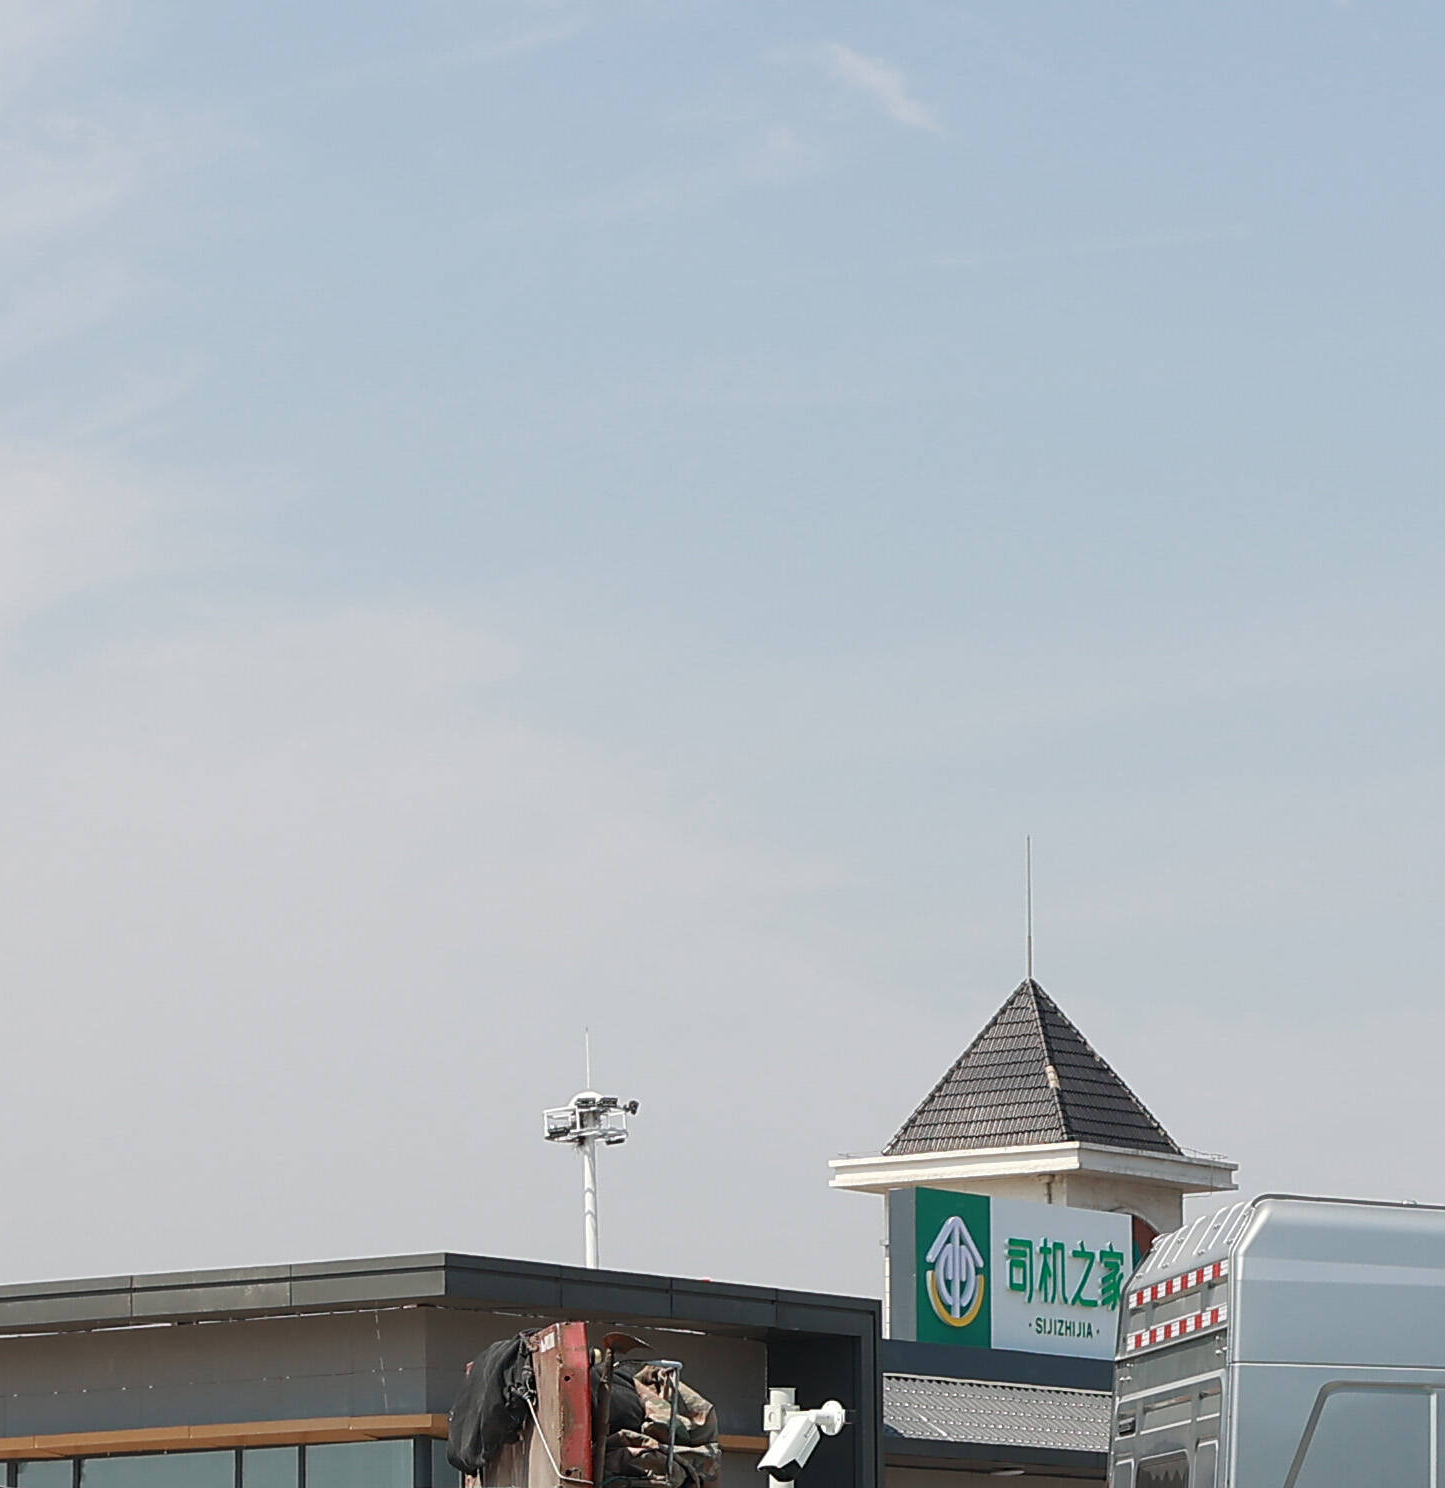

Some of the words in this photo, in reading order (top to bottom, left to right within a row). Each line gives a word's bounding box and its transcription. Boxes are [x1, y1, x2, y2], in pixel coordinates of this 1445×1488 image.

[1007, 1238, 1123, 1311] 司机之家
[1036, 1317, 1093, 1338] SIJIZHIJIA
